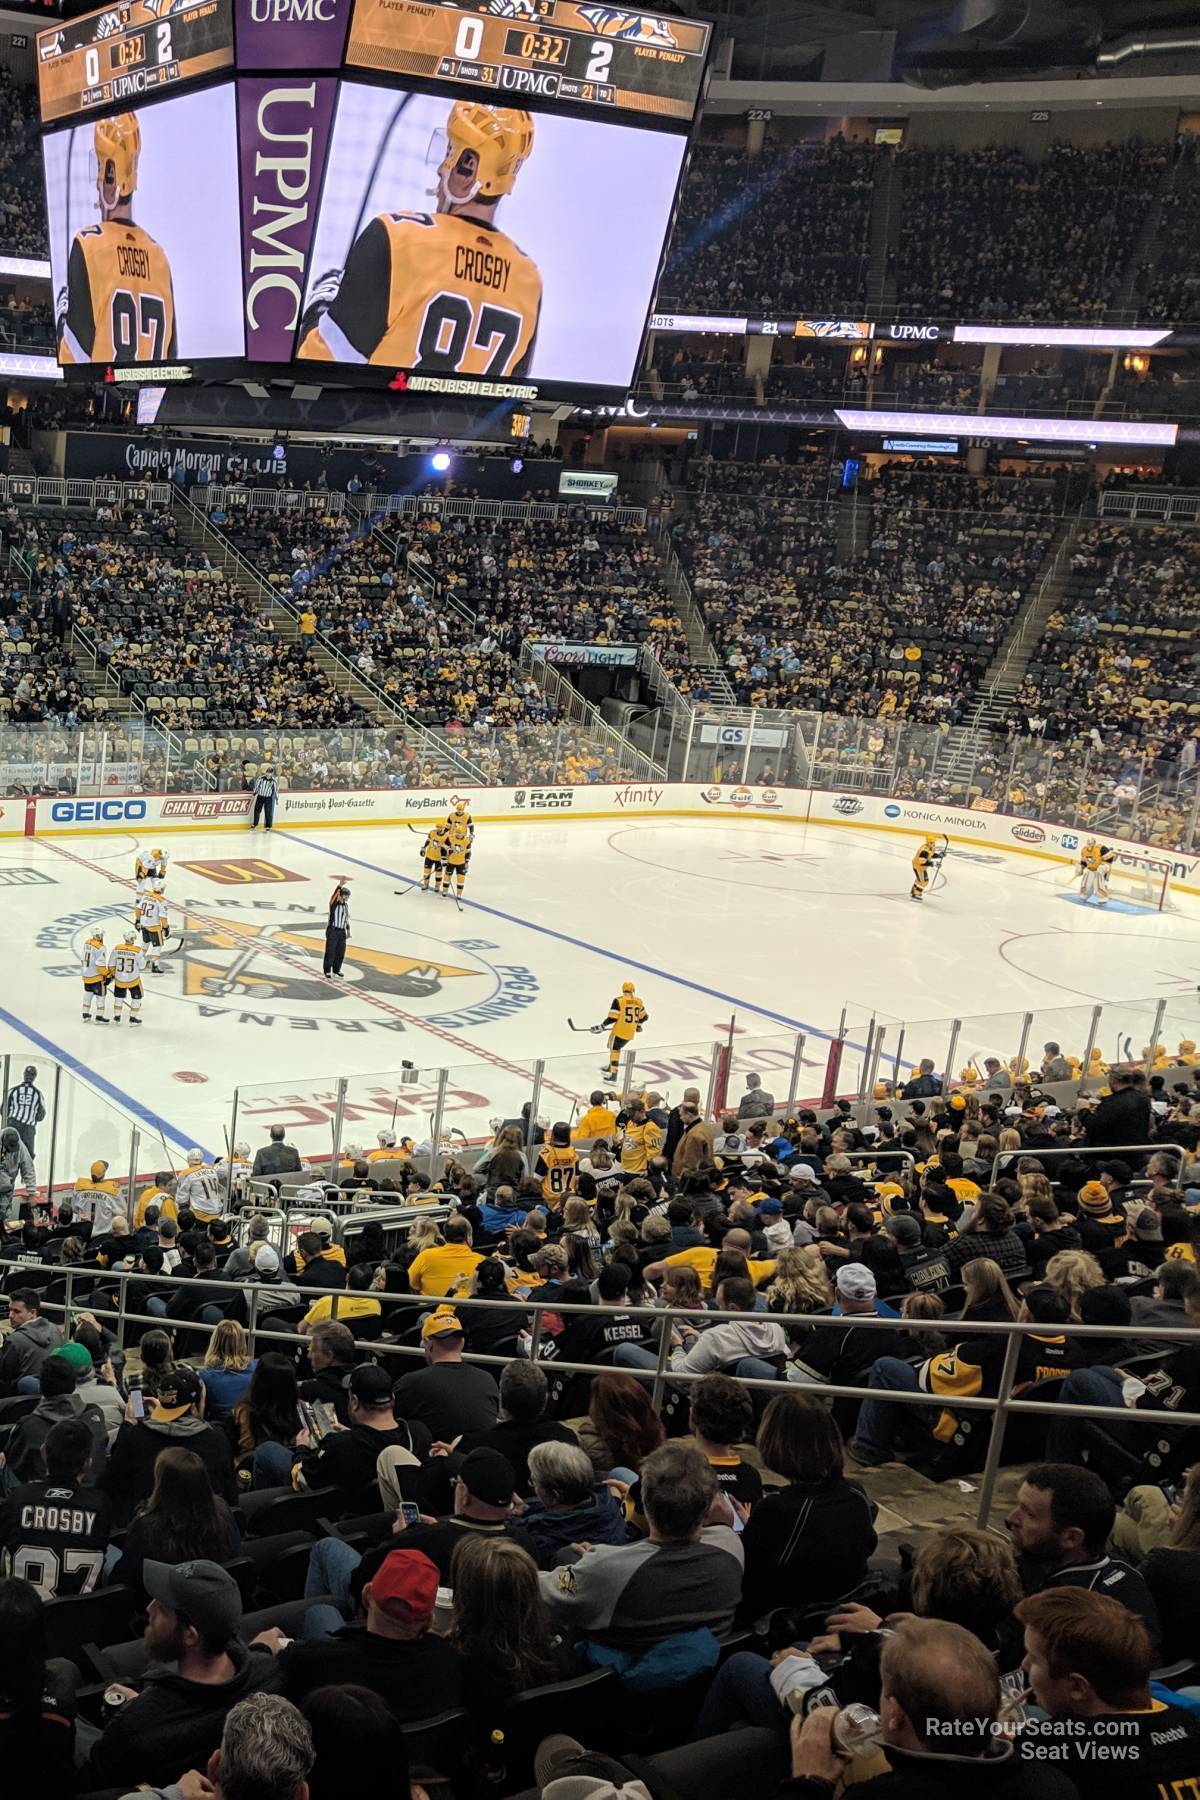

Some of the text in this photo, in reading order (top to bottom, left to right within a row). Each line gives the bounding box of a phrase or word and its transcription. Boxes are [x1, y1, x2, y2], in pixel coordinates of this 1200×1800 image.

[250, 0, 336, 22] UPMC
[406, 4, 436, 18] PENALTY
[539, 3, 549, 15] 3
[157, 22, 173, 65] 2
[455, 16, 484, 60] 0
[118, 38, 142, 66] 0:32
[520, 33, 564, 63] 0:32
[634, 46, 686, 64] PLAYER PENALTY
[85, 48, 99, 86] 0
[586, 41, 614, 82] 2
[481, 67, 494, 83] 31
[502, 67, 558, 96] UPMC
[114, 72, 145, 98] UPMC
[580, 84, 594, 99] 21
[747, 110, 773, 121] 224
[1031, 111, 1049, 122] 225
[246, 82, 316, 333] UPMC
[116, 245, 151, 282] CROSBY
[455, 245, 510, 293] CROSBY
[761, 321, 779, 335] 21
[890, 325, 939, 340] UPMC
[114, 366, 192, 381] MITSUBISHI ELECTRIC
[410, 375, 538, 400] MITSUBISHI ELECTRIC
[12, 482, 32, 495] 113
[128, 488, 146, 500] 113
[229, 493, 247, 504] 114
[309, 497, 326, 508] 114
[422, 502, 440, 514] 115
[543, 645, 624, 666] Coors LIGHT
[722, 729, 743, 743] GS
[285, 798, 376, 811] Pittsburgh Post-Gazette
[405, 798, 448, 808] KeyBank
[530, 792, 574, 800] RAM
[614, 786, 664, 808] xfinity
[729, 794, 752, 803] Gulf
[832, 796, 864, 813] NHL
[52, 800, 146, 822] GEICO
[903, 811, 987, 830] KONICA MINOLTA
[1011, 826, 1047, 842] Glidden
[1051, 833, 1060, 843] by
[66, 902, 136, 930] PAINT
[34, 916, 74, 949] PPG
[116, 957, 135, 974] 33
[495, 965, 540, 992] PPG
[426, 988, 537, 1028] PAINTS
[625, 1006, 640, 1023] 59
[195, 1004, 407, 1033] ARENA
[19, 1094, 32, 1105] 92
[241, 1090, 491, 1131] GNC
[551, 1168, 574, 1193] 87
[604, 1325, 643, 1342] KESSEL
[714, 1473, 738, 1481] eebok
[21, 1505, 97, 1536] CROSBY
[1150, 1724, 1189, 1746] Reebok
